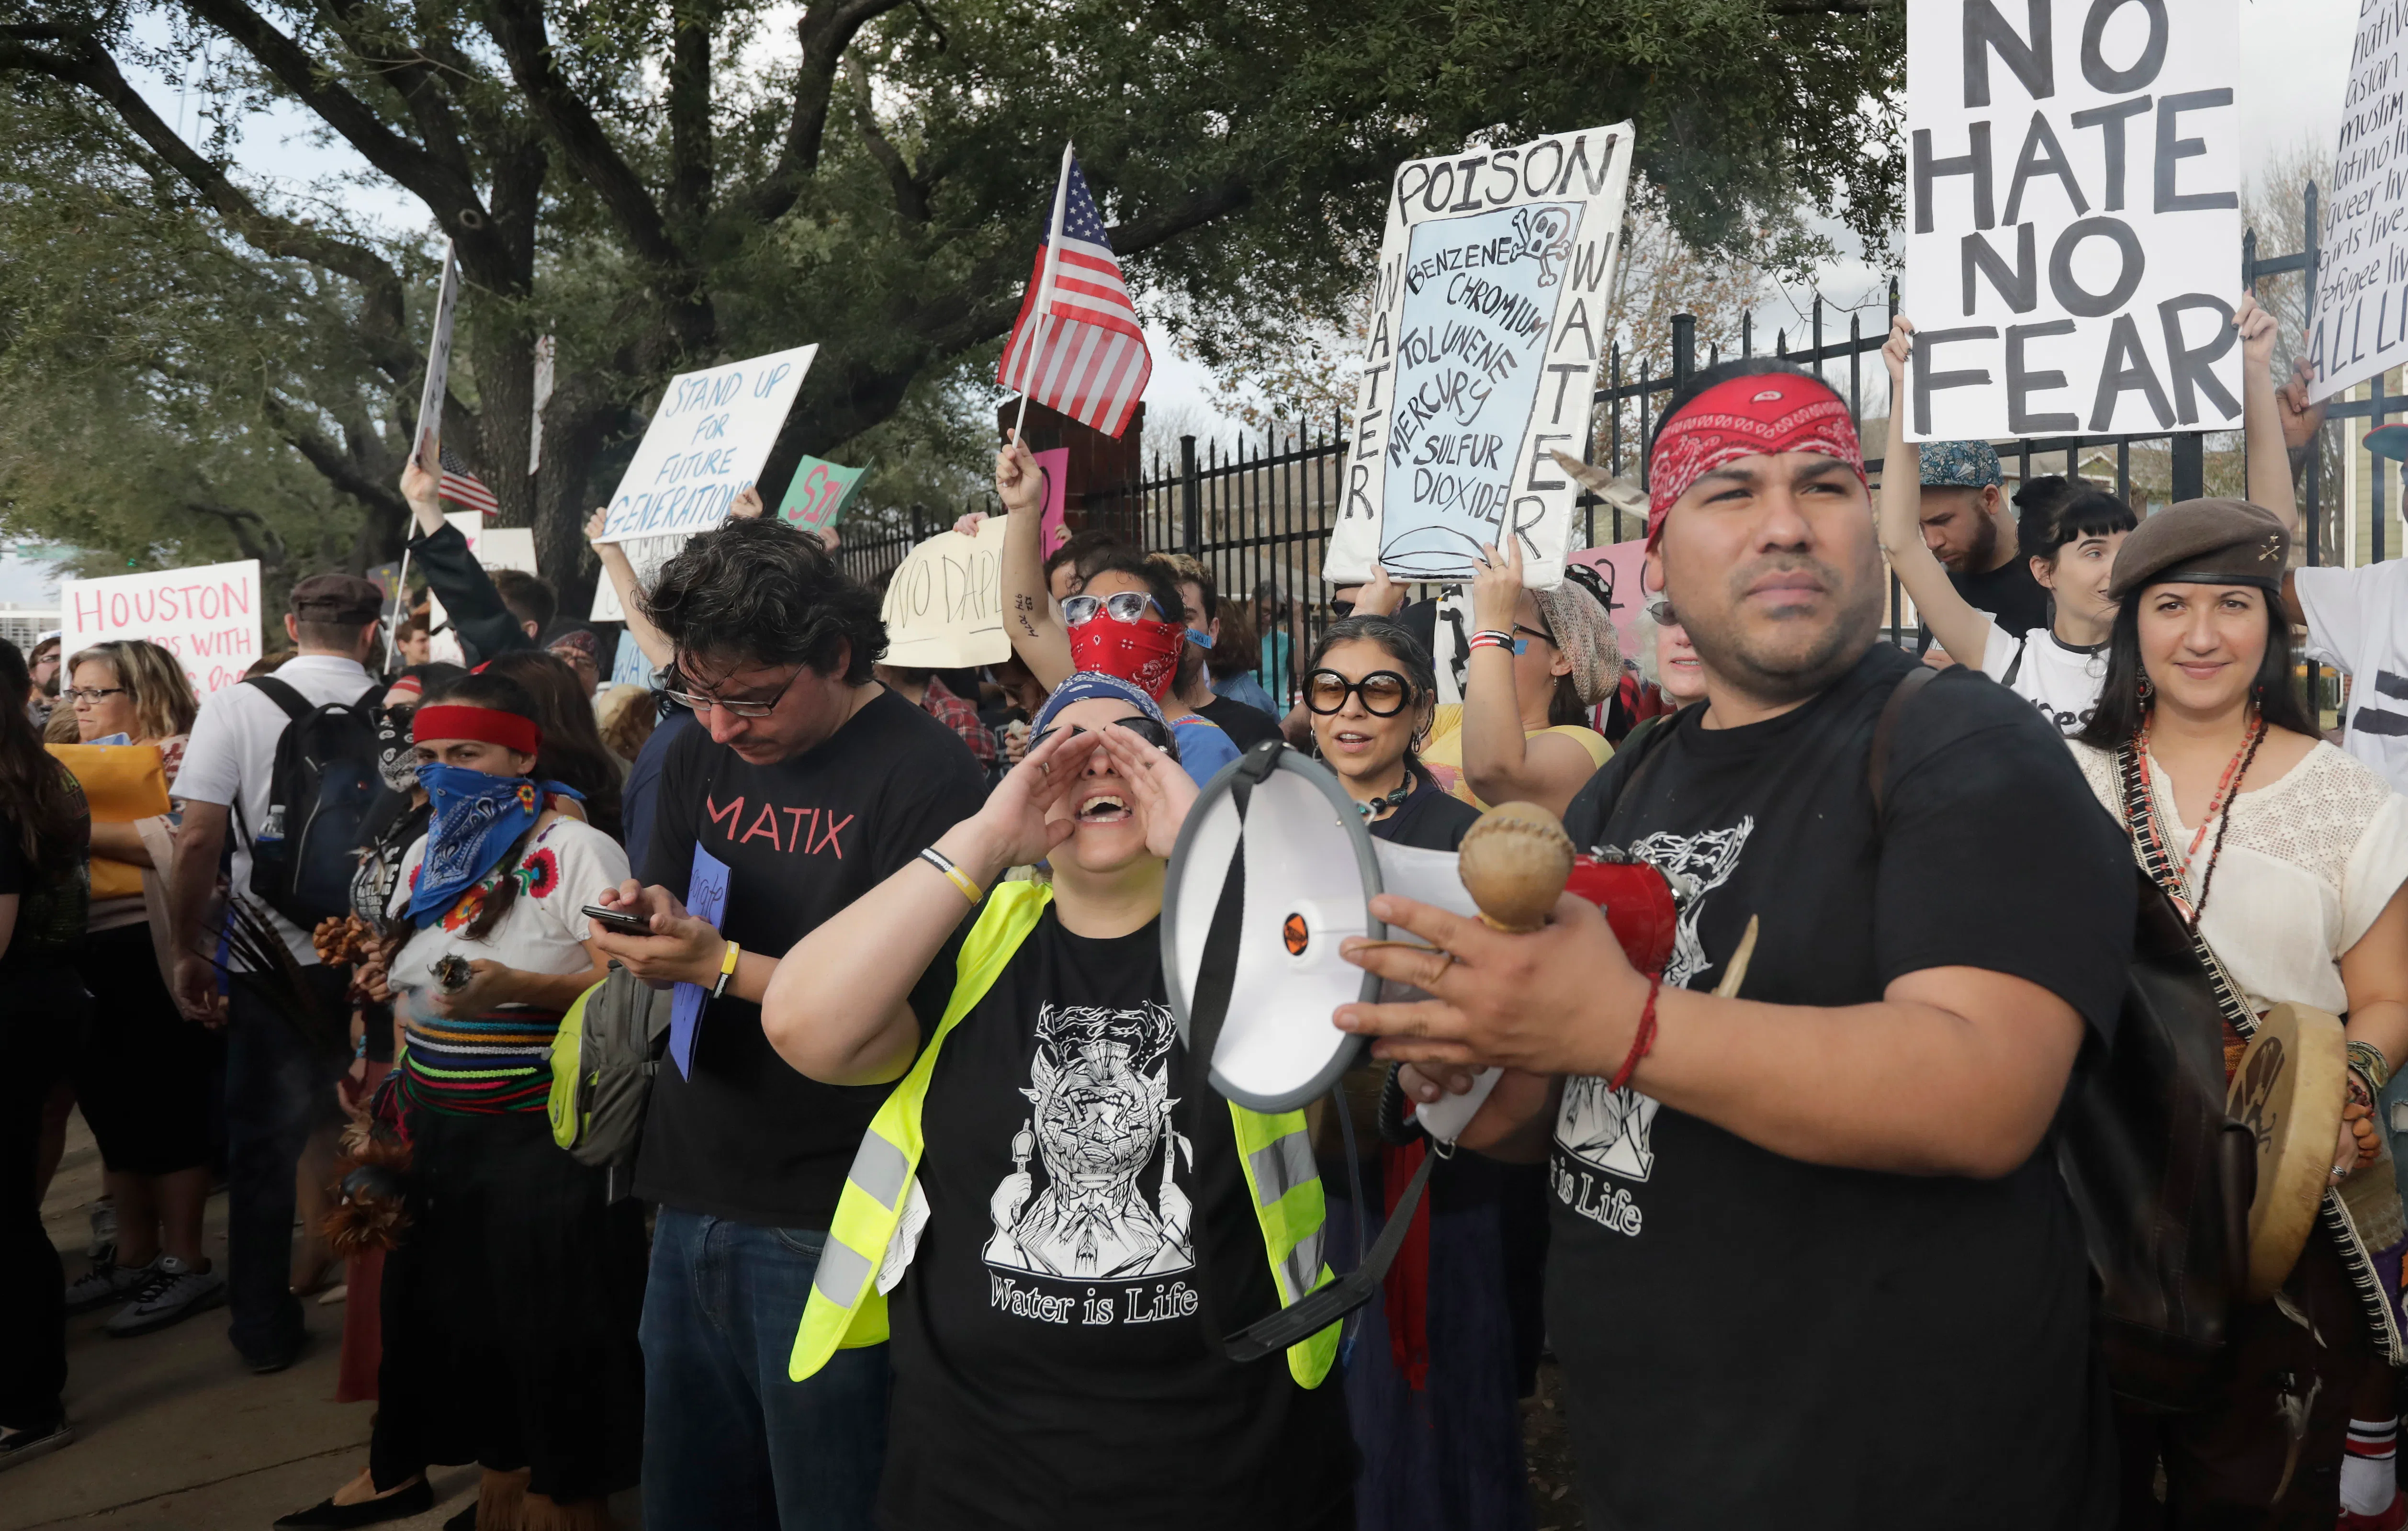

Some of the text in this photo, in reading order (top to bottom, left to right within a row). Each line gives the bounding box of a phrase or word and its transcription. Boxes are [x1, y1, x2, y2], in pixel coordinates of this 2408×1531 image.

[1963, 0, 2169, 108] NO
[2346, 52, 2397, 109] asian
[1397, 134, 1618, 226] POISON
[1912, 88, 2238, 234] HATE
[2334, 135, 2389, 192] latino
[2327, 181, 2381, 241] queer
[2369, 207, 2408, 248] live
[1406, 237, 1512, 294] BENZENE
[1961, 216, 2145, 317] NO
[2313, 259, 2380, 318] refugee
[1447, 272, 1550, 349] CHROMIUM
[2310, 295, 2365, 383] ALL
[1398, 319, 1518, 383] TOLUNENE
[1913, 293, 2242, 435] FEAR
[666, 363, 790, 418] STAND UP
[1345, 253, 1402, 519] WATER
[1513, 232, 1614, 559] WATER
[691, 413, 730, 446] FOR
[1413, 434, 1503, 471] SULFUR
[654, 447, 737, 485] FUTURE
[1414, 468, 1510, 526] DIOXIDE
[75, 577, 248, 632] HOUSTON
[886, 557, 930, 628] NO
[1014, 594, 1024, 611] 974
[191, 628, 251, 656] WITH
[707, 793, 855, 859] MATIX
[1558, 1157, 1574, 1204] is
[1575, 1172, 1642, 1237] Life
[989, 1269, 1198, 1325] Water is Life
